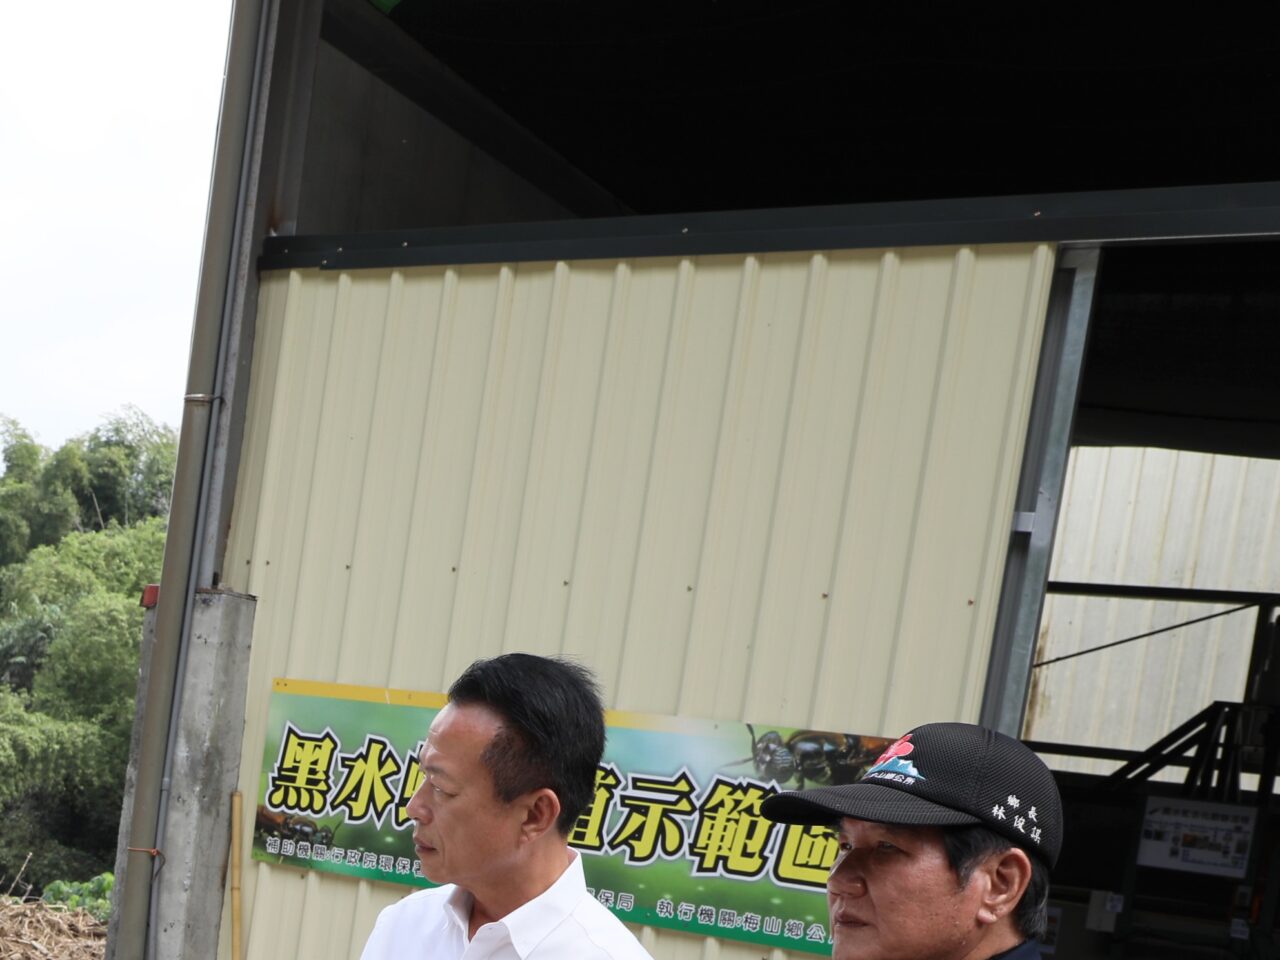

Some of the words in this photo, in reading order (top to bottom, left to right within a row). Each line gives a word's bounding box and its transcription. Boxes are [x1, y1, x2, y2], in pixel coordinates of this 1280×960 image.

[656, 898, 834, 944] 執行機關:梅山鄉公
